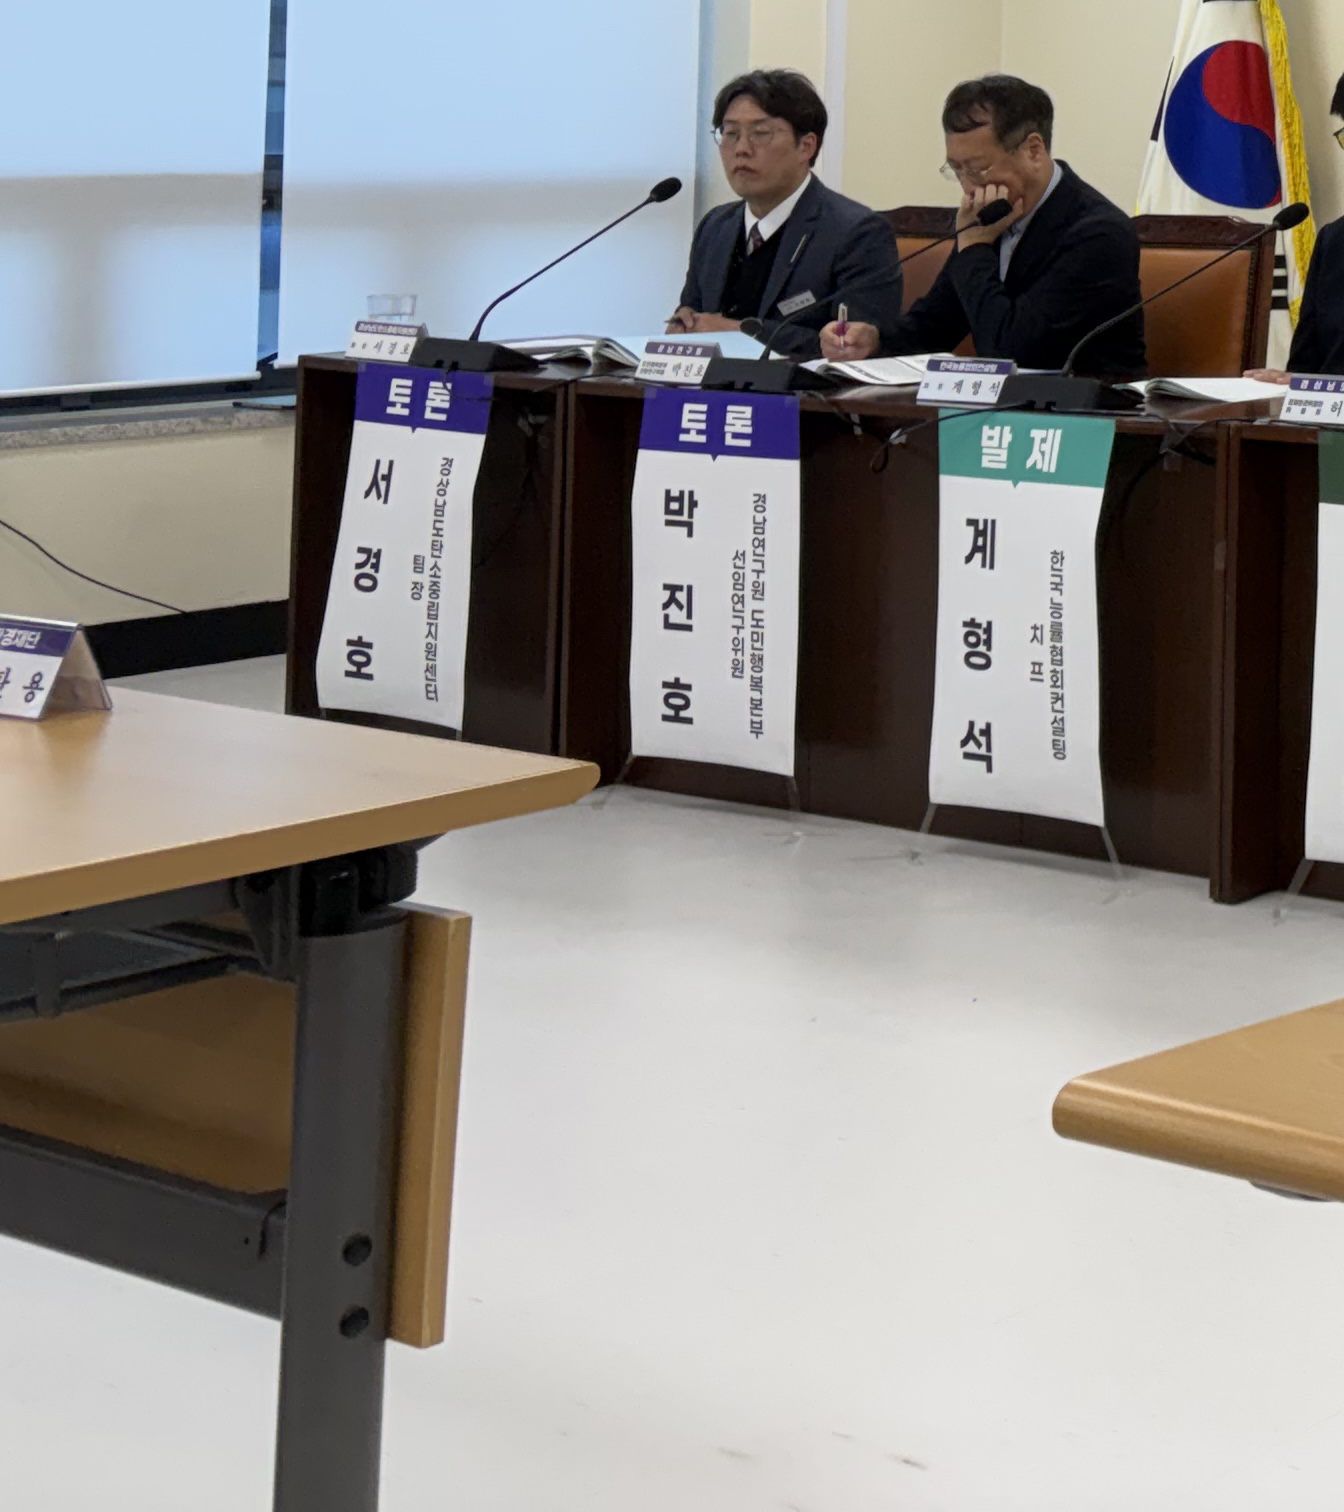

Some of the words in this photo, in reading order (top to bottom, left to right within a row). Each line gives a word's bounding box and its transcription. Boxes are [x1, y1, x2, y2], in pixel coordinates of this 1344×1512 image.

[424, 457, 454, 702] 경상남도탄소중립지원센터
[751, 493, 767, 601] 경남연구원
[0, 628, 41, 648] 경재단
[731, 550, 746, 679] 선임연구위원
[750, 609, 764, 739] 도민행복본부
[1049, 549, 1066, 760] 한국능률협회컨설팅
